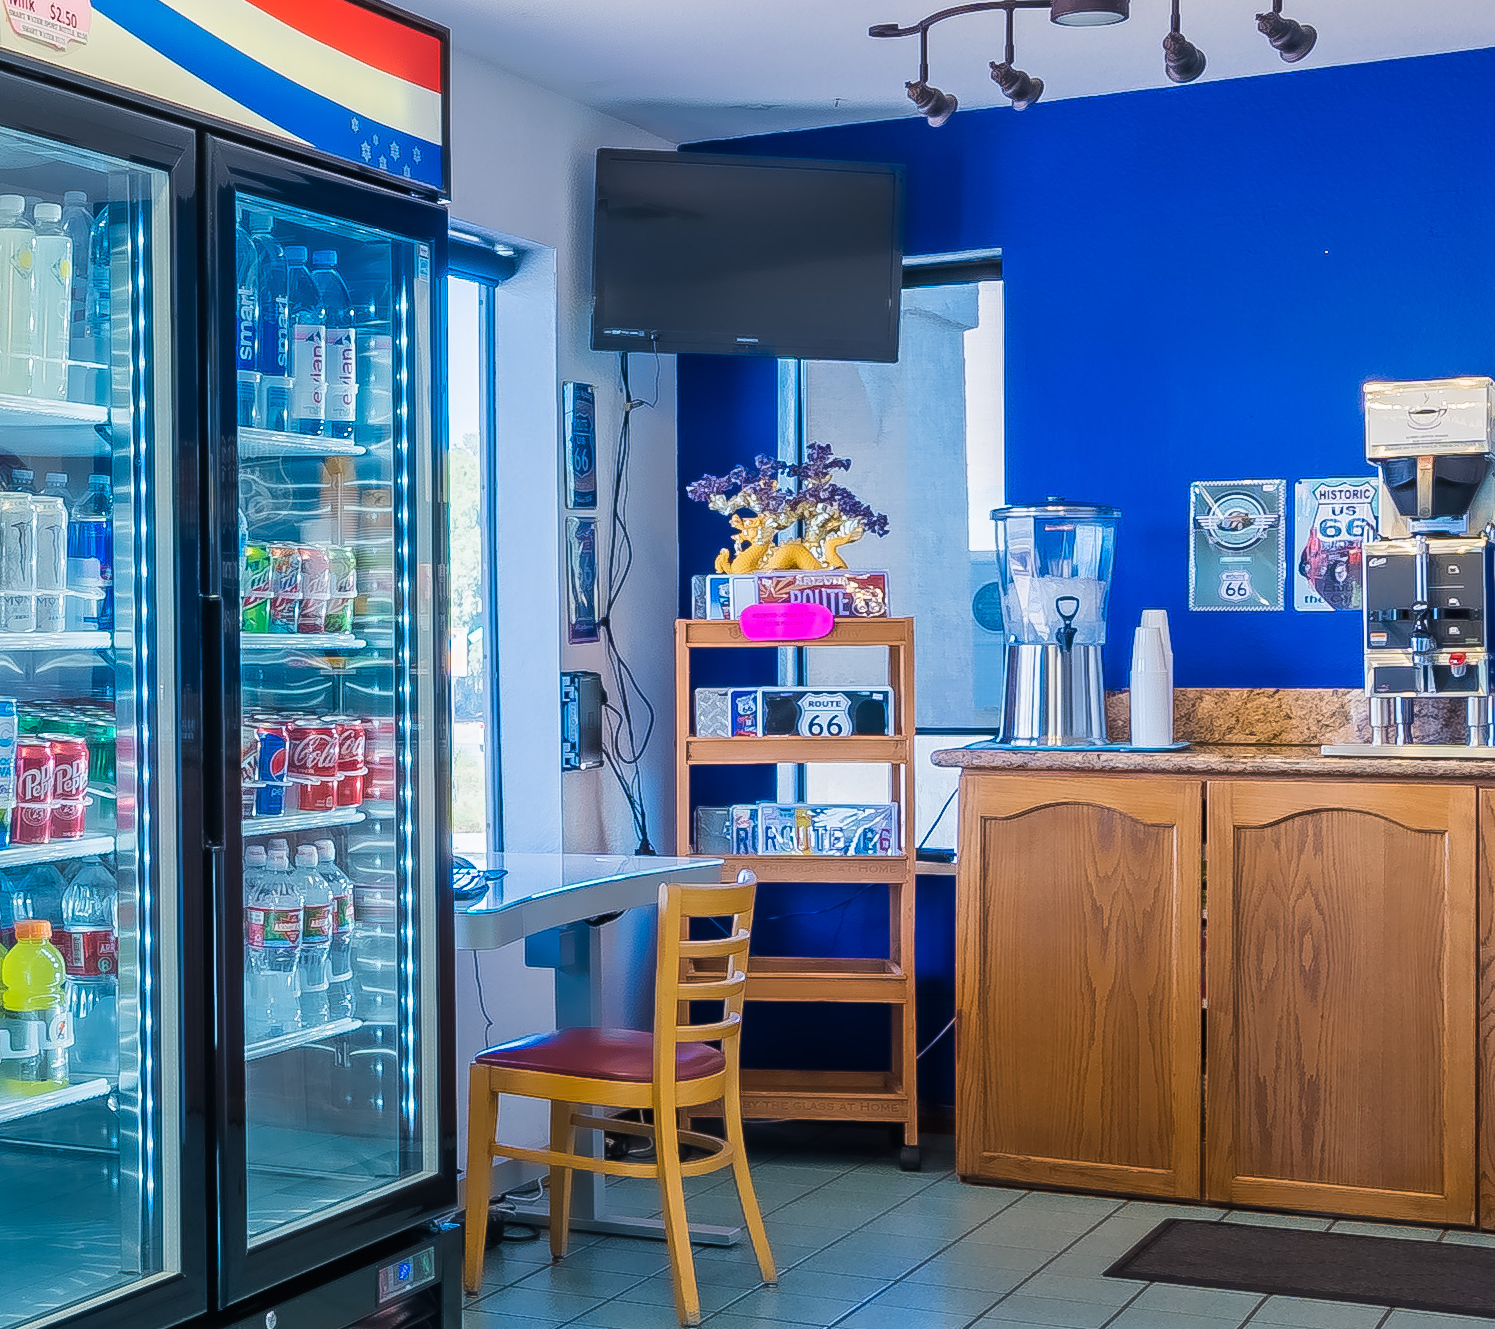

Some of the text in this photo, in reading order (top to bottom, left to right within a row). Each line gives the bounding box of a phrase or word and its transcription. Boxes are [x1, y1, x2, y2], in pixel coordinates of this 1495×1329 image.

[50, 1, 78, 29] $2.50
[238, 284, 254, 361] smart
[275, 294, 288, 368] smart
[310, 345, 324, 404] evian
[340, 348, 354, 406] evian
[1319, 488, 1371, 501] HISTORIC
[1331, 505, 1357, 516] US
[1319, 517, 1368, 539] 66
[1225, 582, 1247, 597] 66
[808, 700, 843, 708] ROUTE
[808, 714, 843, 737] 66
[765, 824, 845, 852] ROUTE
[858, 864, 898, 874] HOME
[742, 1100, 900, 1113] BY THE GLASS AT HOME
